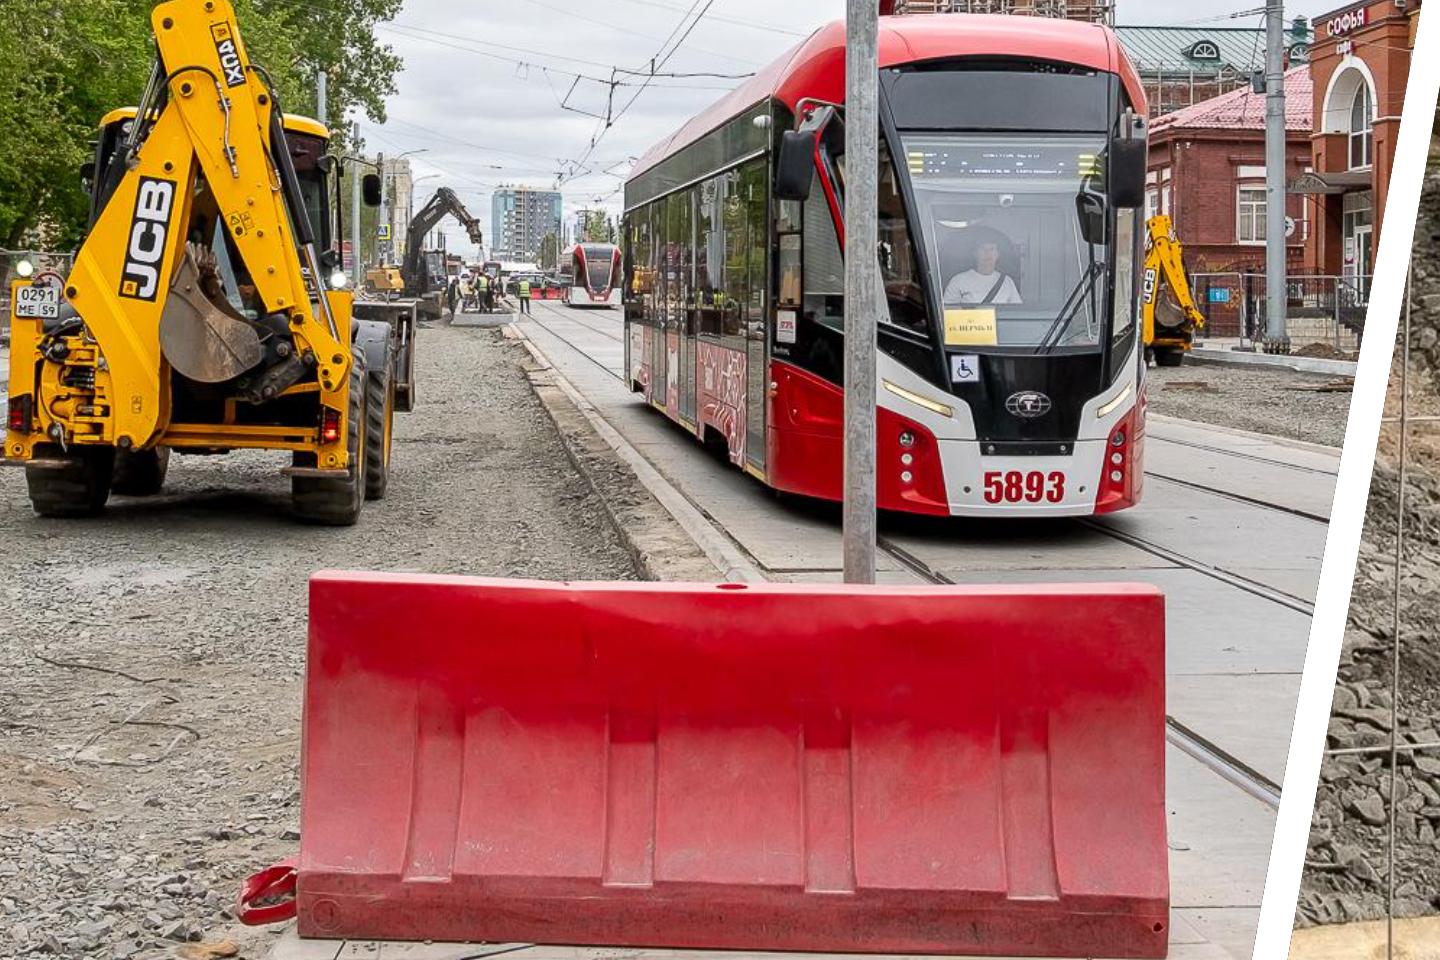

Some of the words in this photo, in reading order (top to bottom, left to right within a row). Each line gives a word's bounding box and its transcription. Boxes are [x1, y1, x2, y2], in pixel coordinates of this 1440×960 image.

[1326, 7, 1365, 36] СОФЬЯ
[218, 39, 245, 86] 4CX
[124, 180, 173, 298] JCB
[21, 289, 55, 302] 0291
[1143, 269, 1156, 304] JCB
[42, 305, 56, 316] 59
[984, 471, 1066, 504] 5893
